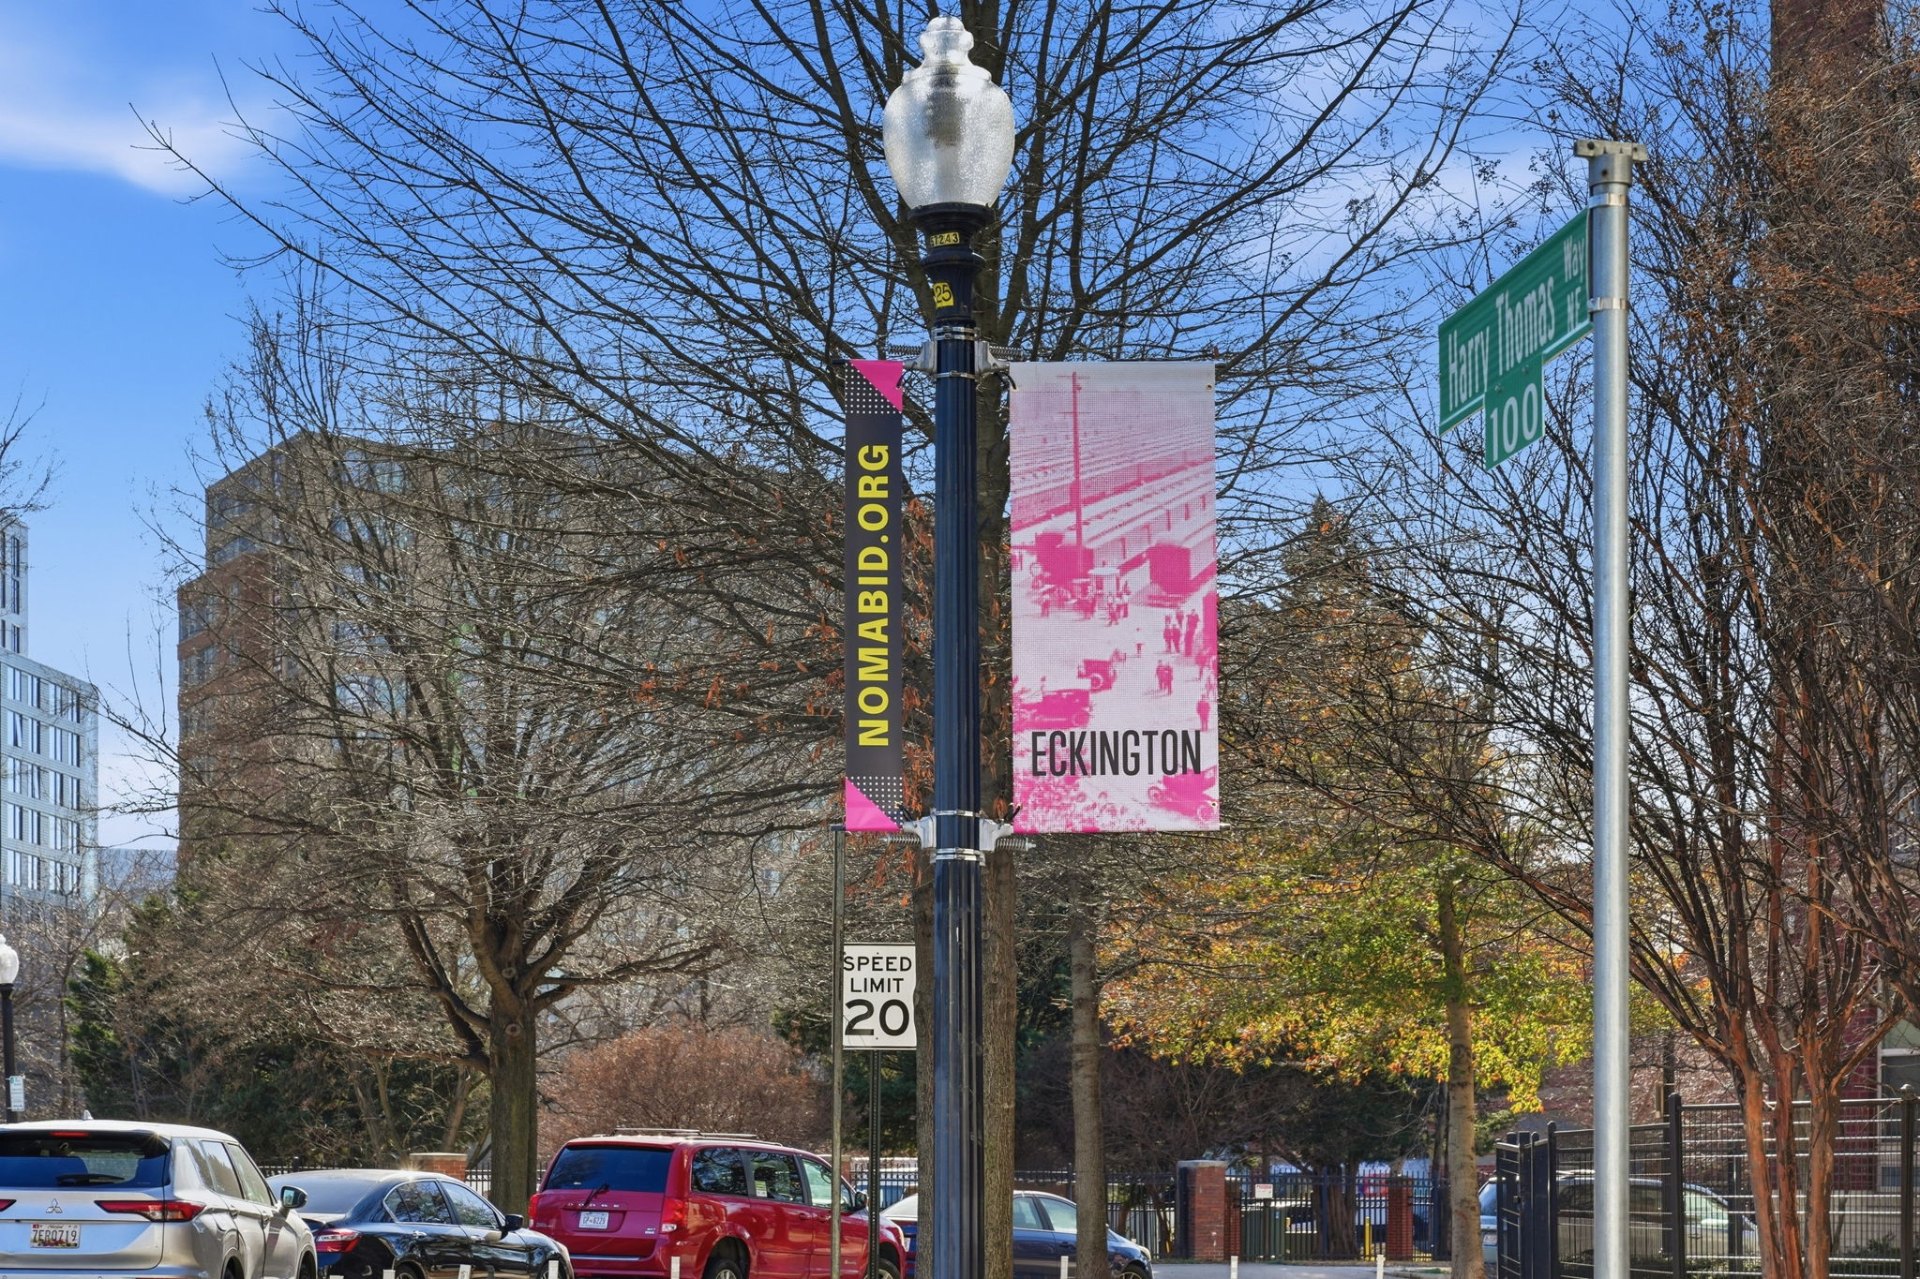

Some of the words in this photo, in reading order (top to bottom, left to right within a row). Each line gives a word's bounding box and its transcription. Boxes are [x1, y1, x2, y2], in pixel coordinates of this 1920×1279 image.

[1563, 235, 1585, 283] Way
[934, 284, 952, 303] 25
[1566, 286, 1581, 333] NE
[1449, 325, 1490, 412] Harry
[1495, 276, 1555, 376] Thomas
[1490, 383, 1538, 462] 100
[858, 445, 889, 746] NOMABID.ORG
[1031, 729, 1201, 777] ECKINGTON
[843, 956, 912, 972] SPEED
[850, 977, 905, 993] LIMIT
[845, 998, 910, 1036] 20
